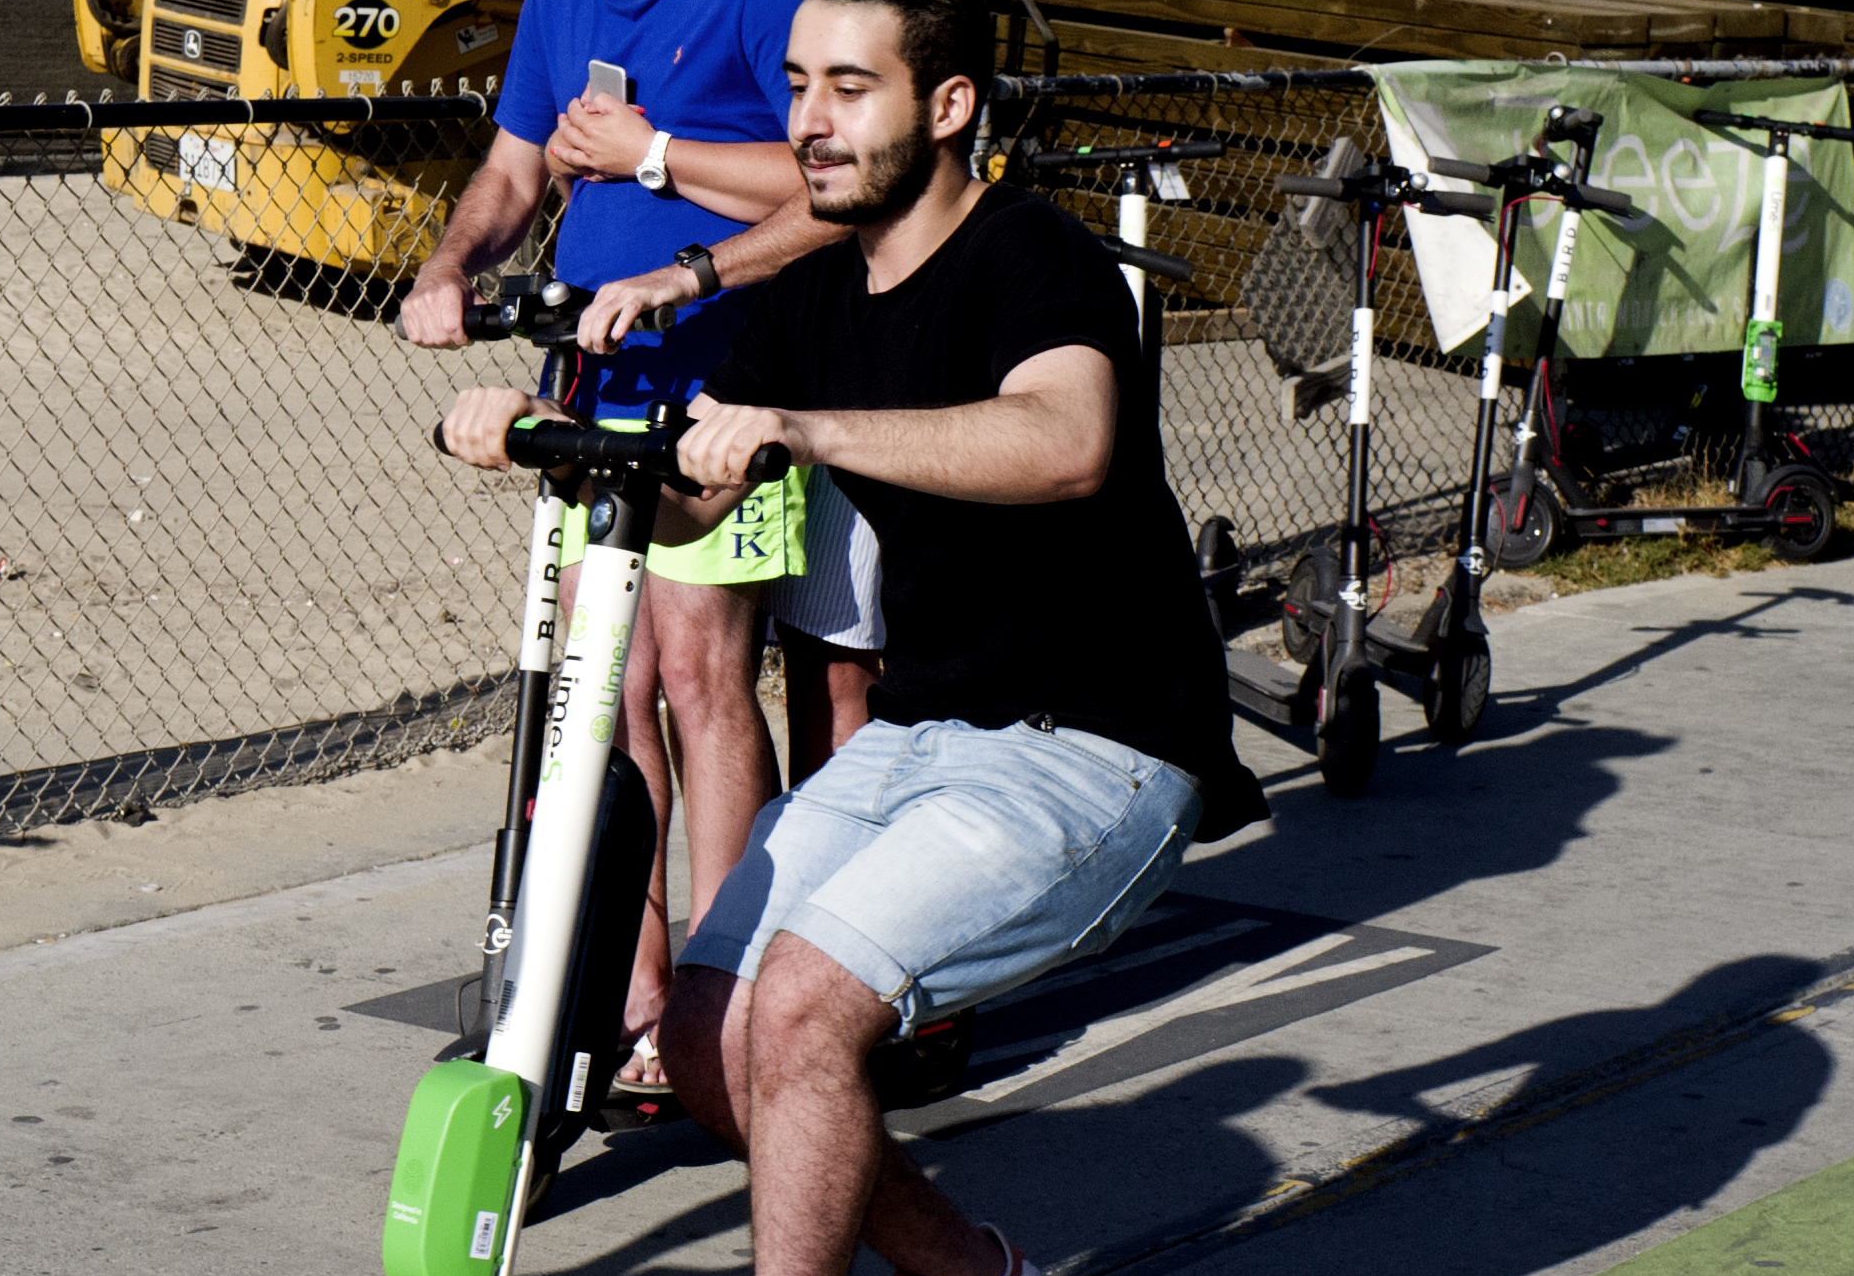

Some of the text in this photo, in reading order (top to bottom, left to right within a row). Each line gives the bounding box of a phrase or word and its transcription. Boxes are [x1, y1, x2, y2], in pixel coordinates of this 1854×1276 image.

[332, 7, 400, 38] 270
[336, 53, 393, 64] 2-SPEED
[1556, 227, 1577, 283] BIRD
[536, 526, 564, 641] BIRD
